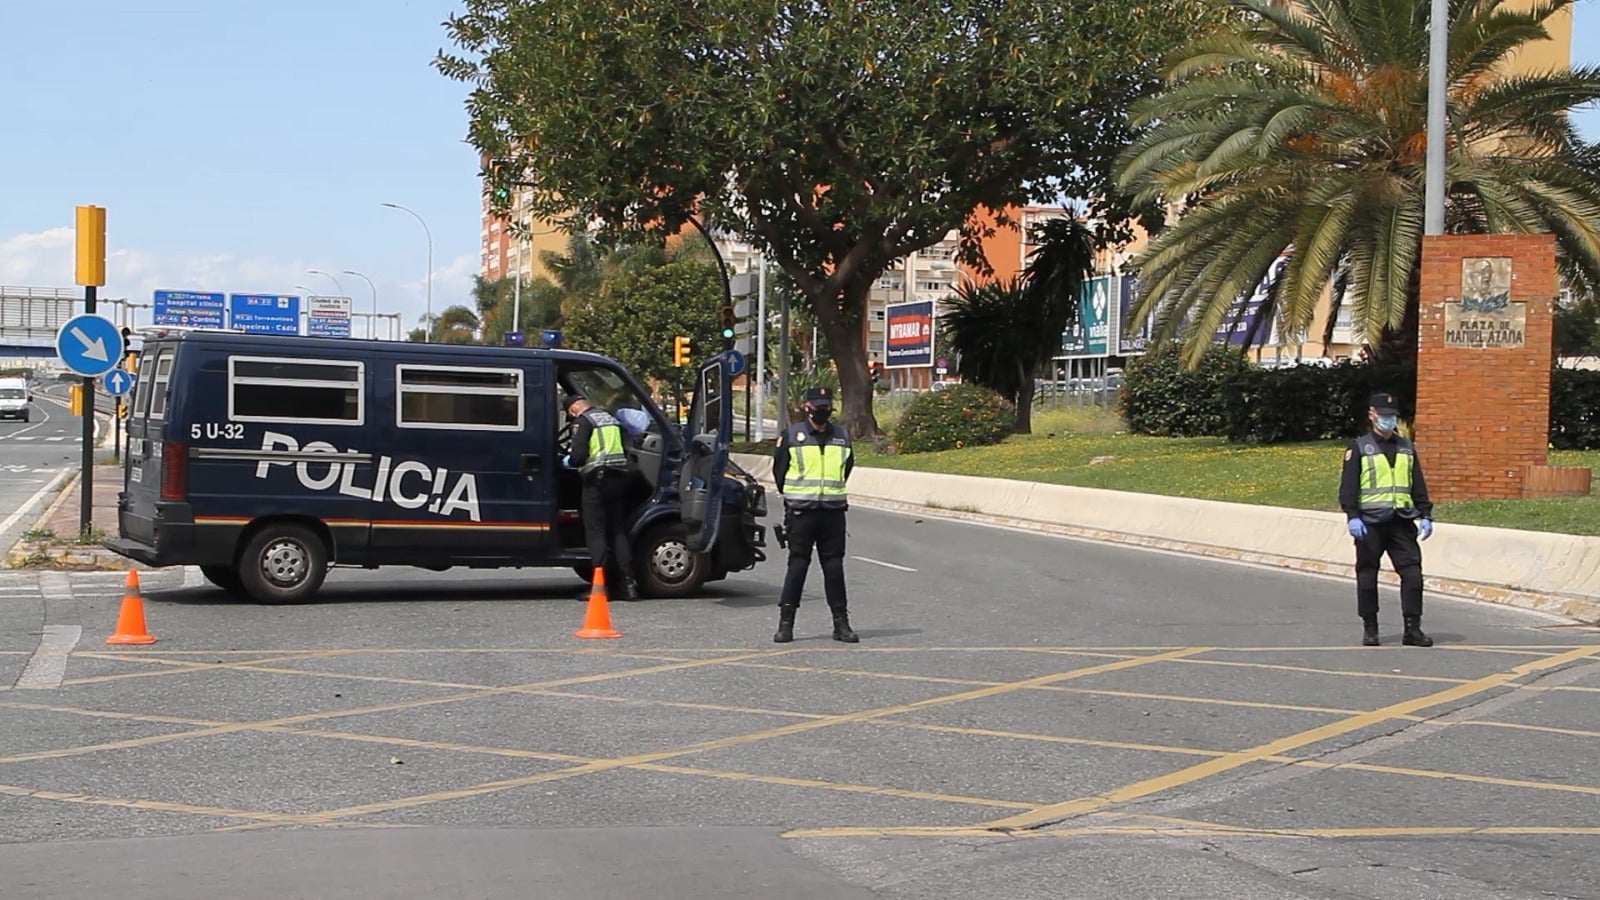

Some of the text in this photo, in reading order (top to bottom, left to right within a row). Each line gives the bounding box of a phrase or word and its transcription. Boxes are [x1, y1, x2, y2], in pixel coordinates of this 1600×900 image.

[166, 299, 197, 307] hospital
[233, 323, 270, 331] Algeciras
[889, 321, 920, 340] MIRAMAR
[1460, 320, 1511, 330] PLAZA DE
[1446, 329, 1483, 343] MANUEL
[190, 423, 245, 440] 5 U-32
